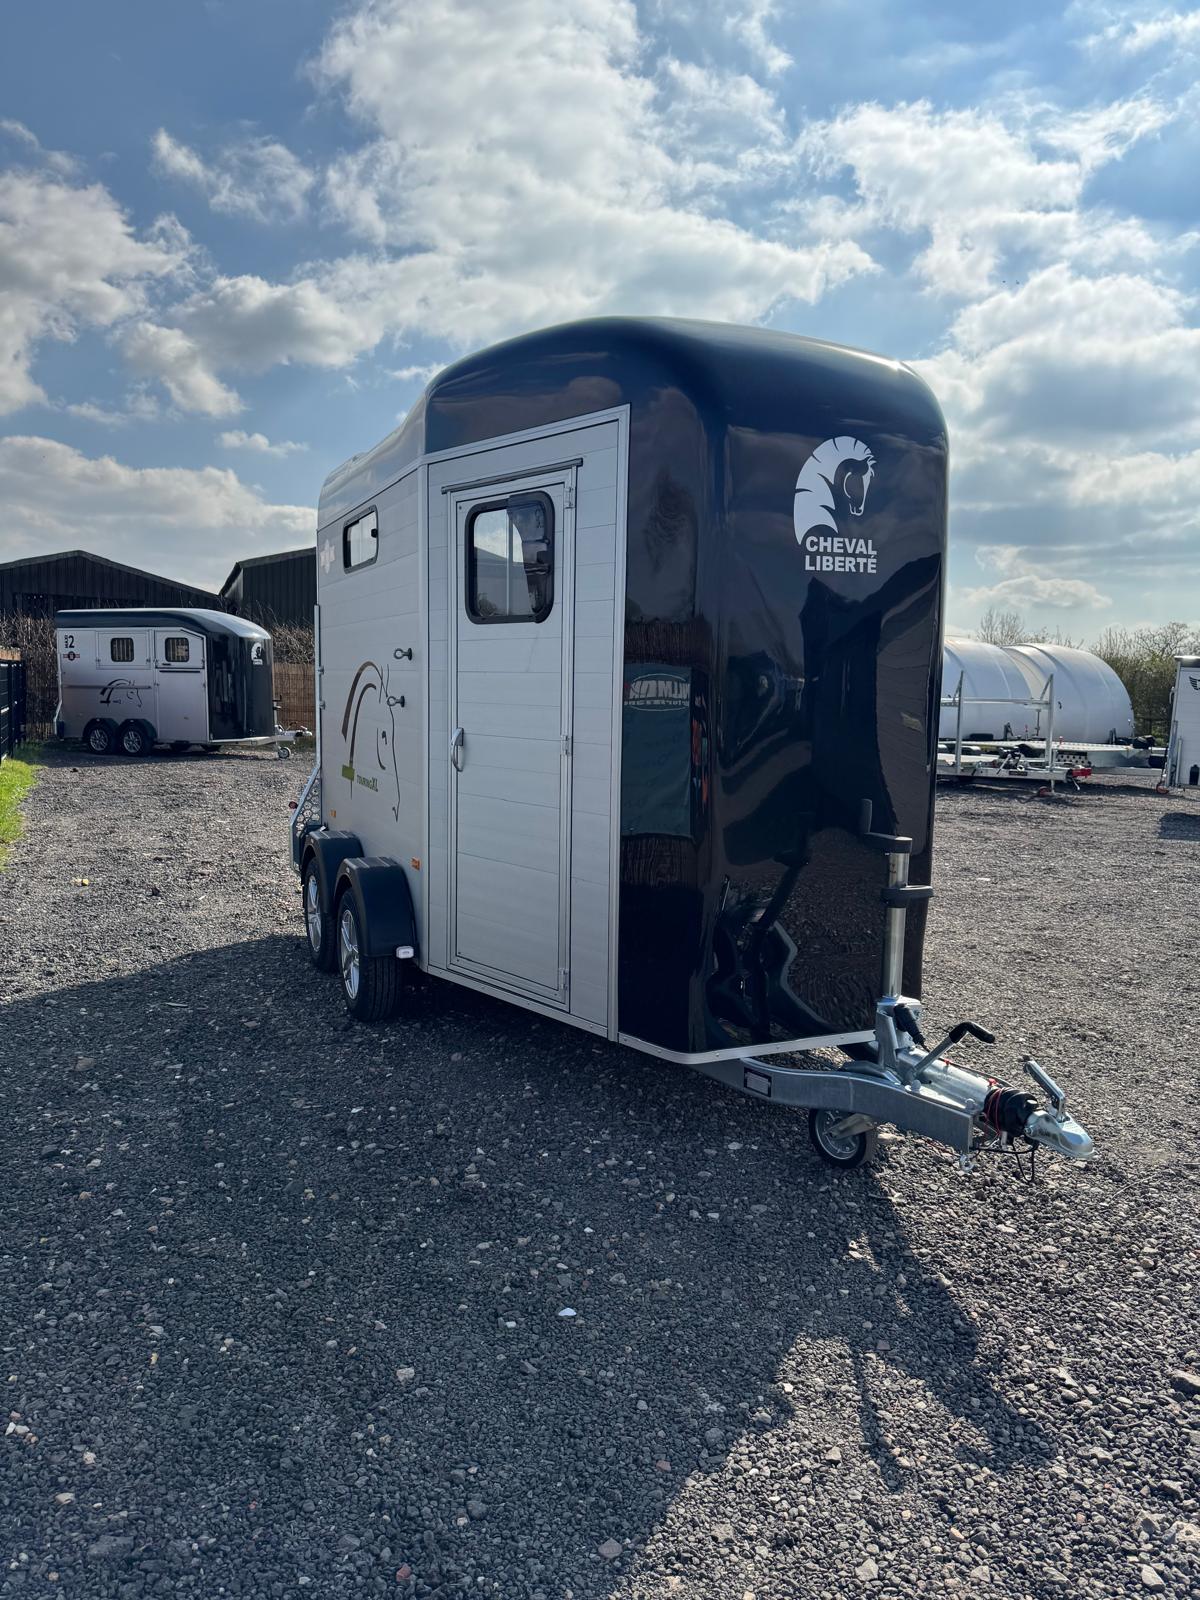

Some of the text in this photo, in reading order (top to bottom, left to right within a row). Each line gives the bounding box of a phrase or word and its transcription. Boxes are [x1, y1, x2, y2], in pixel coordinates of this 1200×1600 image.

[805, 535, 877, 555] CHEVAL
[805, 555, 877, 574] LIBERTÉ
[68, 635, 75, 649] 2
